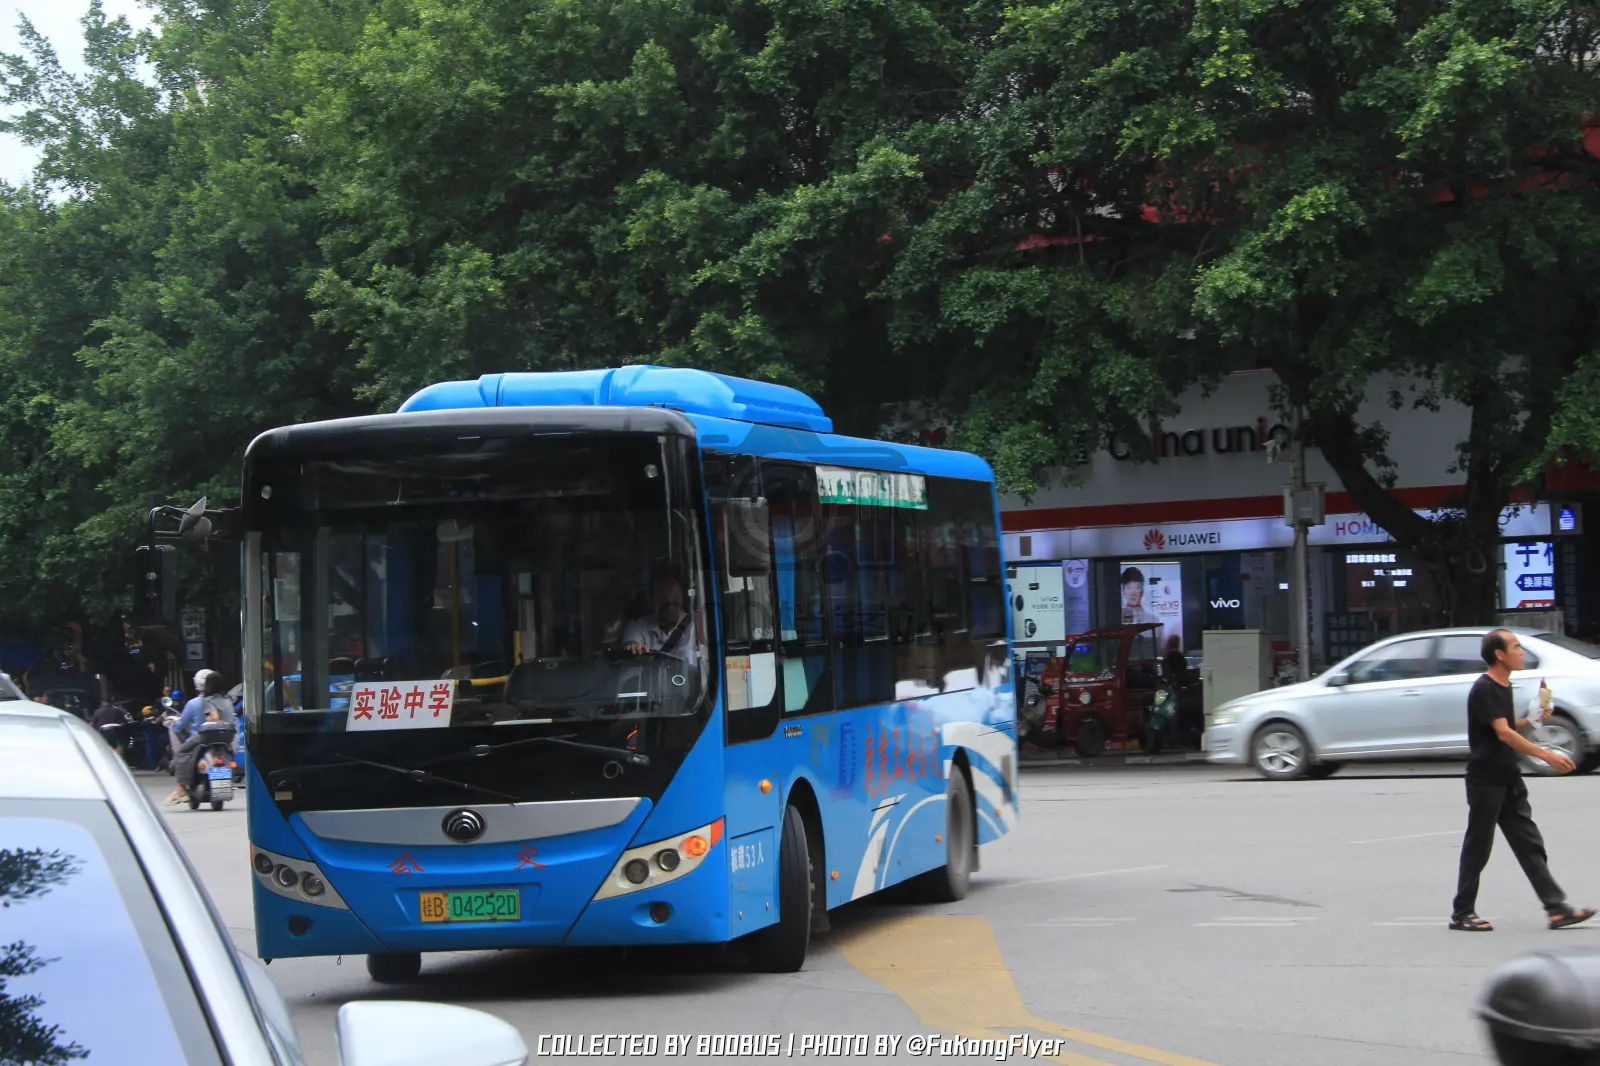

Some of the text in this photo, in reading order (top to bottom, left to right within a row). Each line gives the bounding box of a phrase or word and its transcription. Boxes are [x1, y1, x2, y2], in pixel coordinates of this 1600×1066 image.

[1109, 425, 1202, 461] Cina
[1168, 532, 1221, 546] HUAWEI
[1209, 597, 1241, 608] vivo
[354, 683, 451, 720] 实验中学
